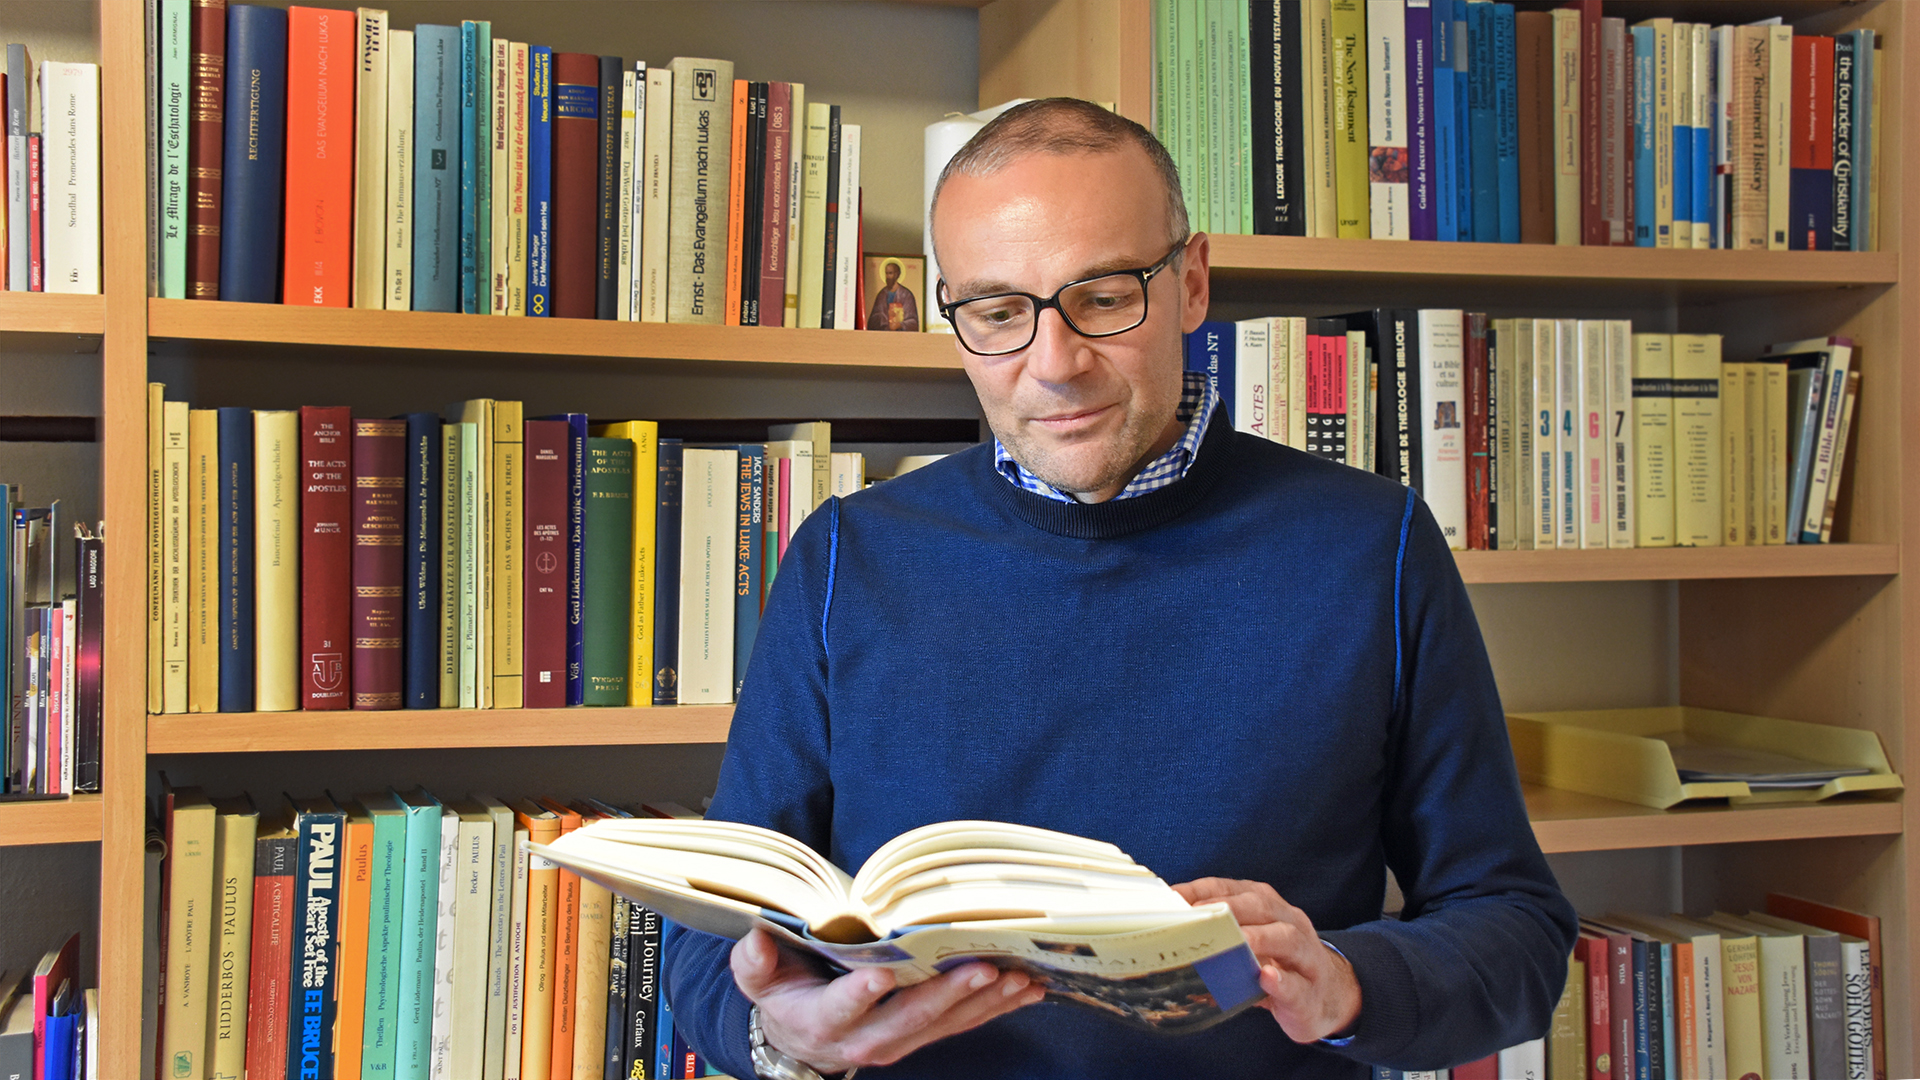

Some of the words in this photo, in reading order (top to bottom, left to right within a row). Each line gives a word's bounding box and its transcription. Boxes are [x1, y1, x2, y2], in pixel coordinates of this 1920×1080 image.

[318, 15, 328, 43] LUKAS
[1336, 39, 1345, 48] in
[1345, 33, 1357, 58] The
[1753, 39, 1765, 69] New
[318, 46, 328, 75] NACH
[514, 50, 524, 76] Lebens
[1273, 44, 1283, 84] NOUVEAU
[1335, 49, 1345, 87] literary
[1345, 59, 1357, 88] New
[1415, 39, 1424, 85] Testament
[1840, 57, 1852, 80] the
[514, 78, 524, 90] des
[1274, 86, 1282, 98] DU
[68, 93, 76, 116] Rome
[249, 69, 261, 161] RECHTFERTIGUNG
[317, 78, 328, 137] EVANGELIUM
[514, 90, 525, 132] Geschmack
[1335, 89, 1346, 130] criticism
[1345, 88, 1357, 143] Testament
[1415, 87, 1425, 124] Nouveau
[1753, 75, 1765, 139] Testament
[1838, 83, 1851, 140] founder
[68, 118, 76, 136] dans
[167, 83, 182, 158] l'Eschatologie
[696, 110, 710, 143] Lukas
[1416, 126, 1425, 138] du
[317, 140, 326, 159] DAS
[514, 133, 523, 145] der
[772, 136, 782, 159] Wirken
[1838, 142, 1850, 157] of
[68, 138, 77, 186] Promenades
[514, 146, 523, 160] wie
[514, 161, 523, 170] ist
[694, 145, 709, 176] nach
[1417, 140, 1425, 170] lecture
[168, 163, 179, 175] de
[1417, 173, 1426, 183] de
[1751, 144, 1764, 192] History
[513, 172, 523, 194] Name
[1276, 164, 1285, 199] LEXIQUE
[68, 193, 77, 227] Stendhal
[167, 181, 180, 219] Mirage
[514, 195, 523, 215] Dein
[1418, 185, 1427, 209] Guide
[1832, 160, 1852, 237] Christianity
[693, 178, 710, 250] Evangelium
[771, 209, 781, 225] Jesu
[166, 226, 179, 239] Le
[532, 234, 540, 258] Taeger
[769, 227, 782, 271] Kirchschläger
[693, 252, 706, 274] Das
[314, 286, 323, 304] EKK
[692, 281, 705, 315] Ernst
[1207, 332, 1218, 352] NT
[1395, 321, 1405, 368] BIBLIQUE
[1209, 354, 1218, 374] das
[1250, 385, 1264, 435] ACTES
[1540, 410, 1550, 436] 3
[1563, 410, 1572, 436] 4
[1615, 411, 1625, 437] 7
[1399, 433, 1409, 446] DE
[1616, 442, 1625, 463] CHRIST
[1818, 431, 1834, 463] Bible
[273, 439, 282, 509] Apostelgeschichte
[573, 437, 582, 496] Christentum
[741, 456, 752, 479] THE
[753, 456, 762, 475] JACK
[1541, 451, 1551, 497] APOSTOLIQUES
[1617, 465, 1626, 483] JESUS
[1815, 468, 1827, 484] La
[740, 482, 751, 513] JEWS
[753, 486, 761, 523] SANDERS
[1541, 498, 1550, 523] LETTRES
[1565, 492, 1573, 525] TRADITION
[1617, 494, 1626, 520] PAROLES
[740, 514, 751, 526] IN
[1541, 524, 1550, 534] LES
[1618, 521, 1626, 531] LES
[273, 519, 281, 566] Bauernfeind
[573, 525, 581, 543] Das
[89, 549, 98, 575] MAGGIORE
[638, 547, 646, 582] Luke-Acts
[738, 529, 750, 596] LUKE-ACTS
[89, 576, 97, 588] LAGO
[571, 601, 580, 625] Gerd
[637, 593, 645, 614] Father
[570, 662, 578, 680] V&R
[273, 846, 285, 873] PAUL
[307, 823, 336, 898] PAUL
[356, 844, 368, 882] Paulus
[472, 836, 480, 864] PAULUS
[273, 881, 281, 889] A
[470, 871, 478, 894] Becker
[225, 877, 238, 936] PAULUS
[271, 889, 281, 929] CRITICAL
[306, 897, 321, 934] Heart
[315, 897, 332, 946] Apostle
[270, 930, 279, 946] LIFE
[304, 935, 318, 958] Set
[316, 949, 332, 963] of
[302, 959, 317, 987] Free
[314, 965, 328, 987] the
[639, 940, 658, 1002] Journey
[219, 951, 234, 1040] RIDDERBOS
[1635, 971, 1645, 1012] Nazareth
[1845, 973, 1863, 1018] SOHN
[635, 1010, 646, 1047] Cerfaux
[1638, 1013, 1646, 1030] von
[300, 1016, 321, 1080] BRUCE
[1637, 1032, 1649, 1056] Jesus
[1847, 1021, 1865, 1080] GOTTES
[686, 1054, 695, 1073] UTB
